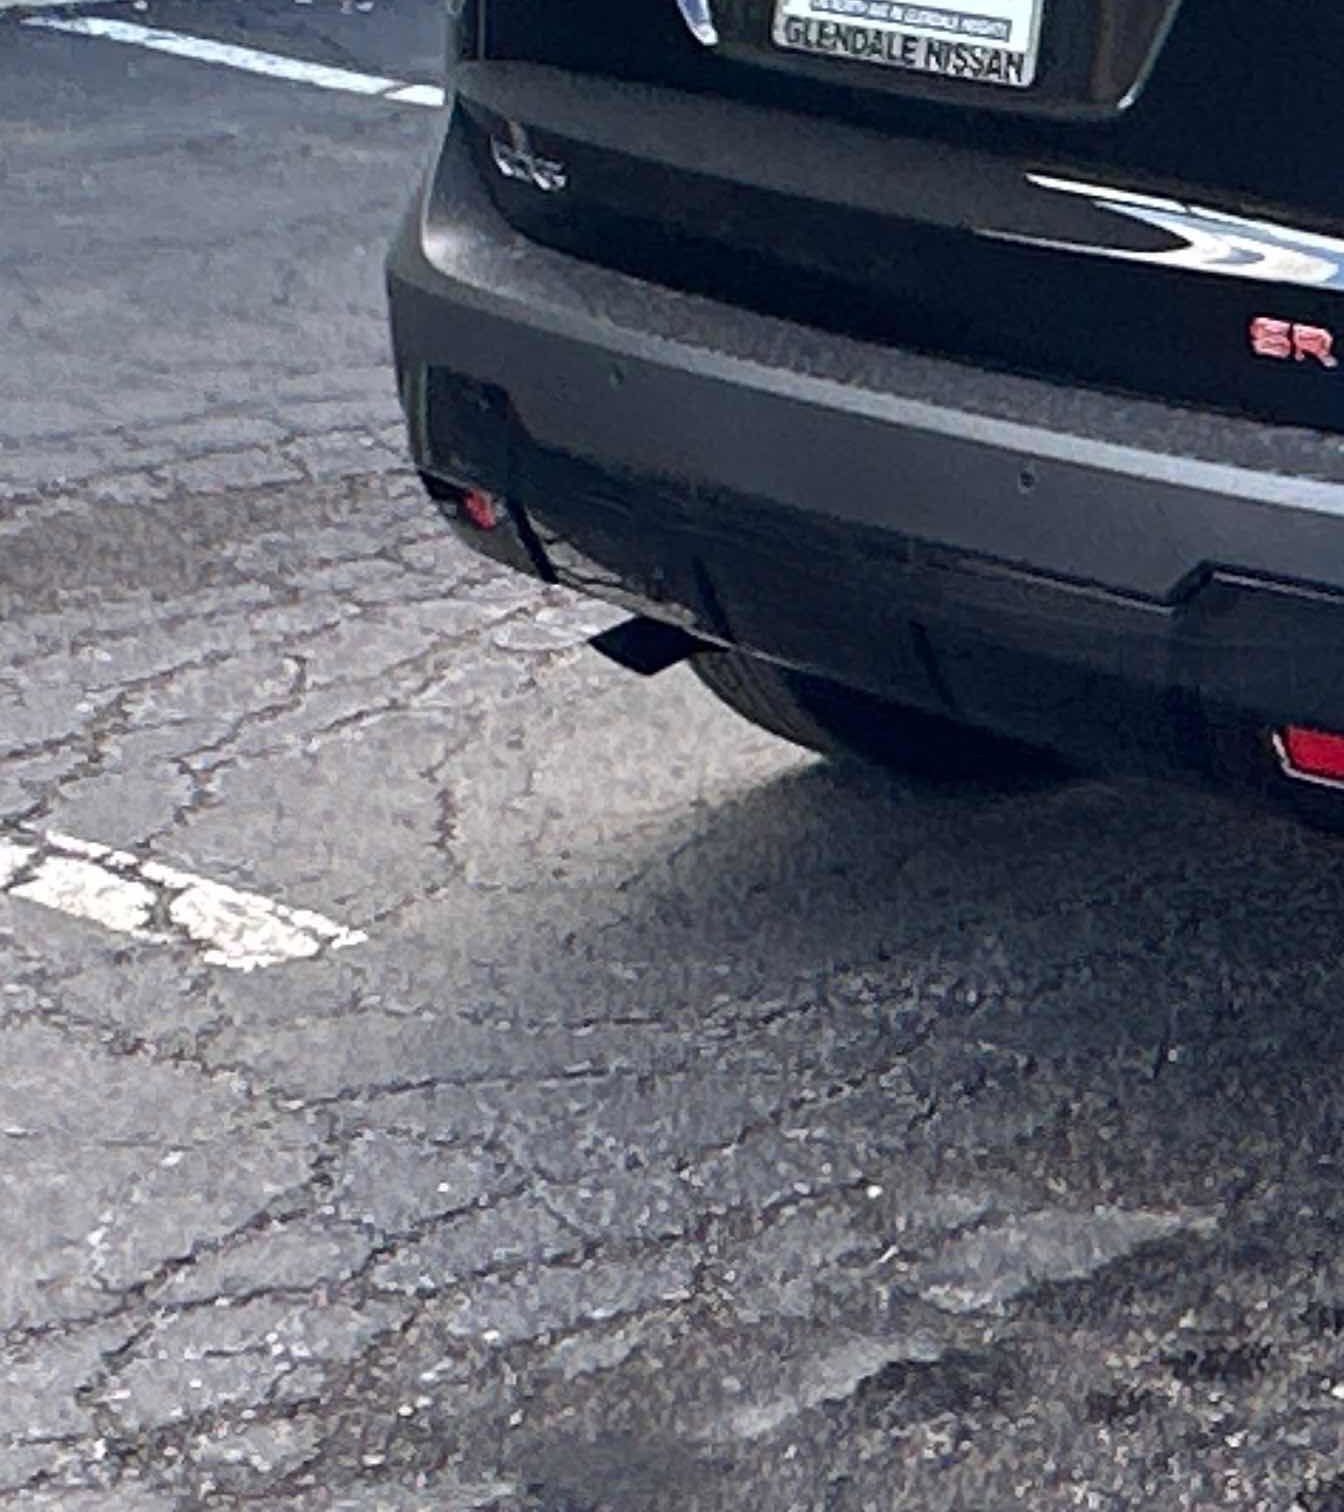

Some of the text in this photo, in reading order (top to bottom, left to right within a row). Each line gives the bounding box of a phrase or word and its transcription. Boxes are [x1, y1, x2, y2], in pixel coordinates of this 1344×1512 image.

[785, 16, 918, 64] GLENDALE
[924, 35, 1023, 83] NISSAN
[1250, 316, 1338, 368] SR
